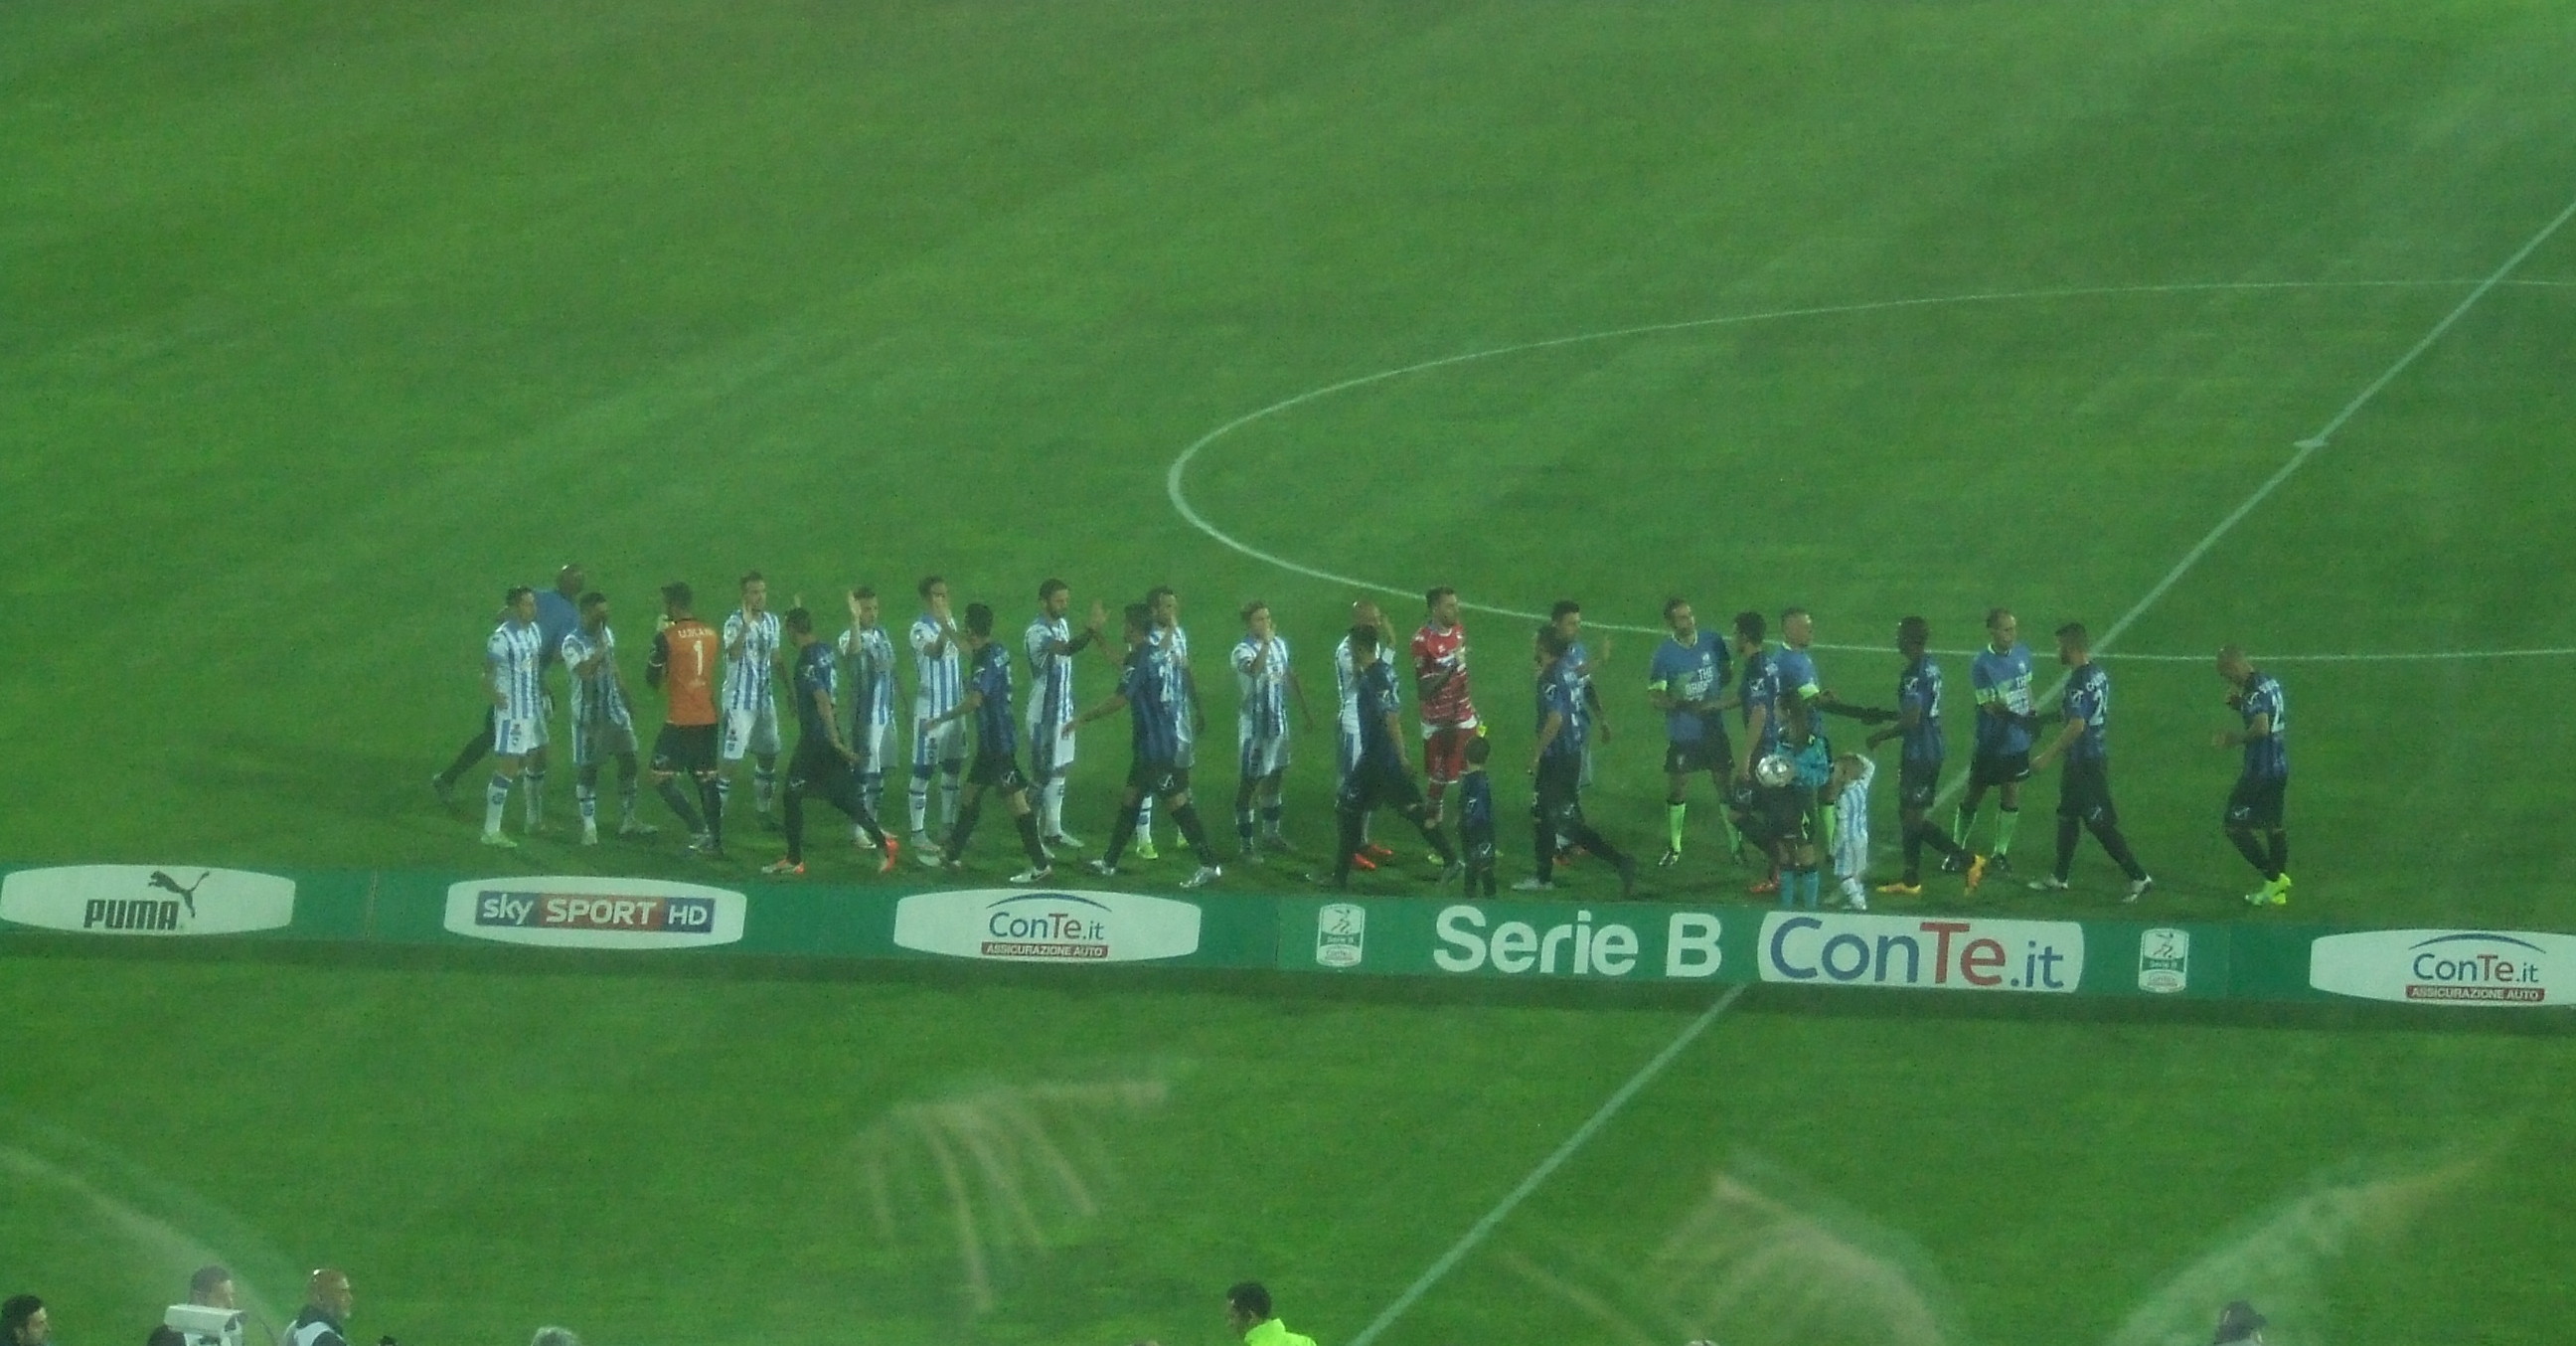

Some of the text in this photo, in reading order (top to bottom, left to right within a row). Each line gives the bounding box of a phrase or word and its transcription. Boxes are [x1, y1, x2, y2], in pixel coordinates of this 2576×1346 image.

[694, 640, 703, 676] 1
[83, 900, 180, 930] PUMA
[483, 894, 708, 926] sky SPORT HD
[989, 912, 1105, 940] ConTe.it
[1433, 905, 1722, 977] Serie B
[986, 943, 1103, 957] ASSICURAZIONE AUTO
[1770, 917, 2064, 989] ConTe.it
[2413, 952, 2539, 983] ConTe.it
[2411, 987, 2539, 1002] ASSICURAZIONE AUTO
